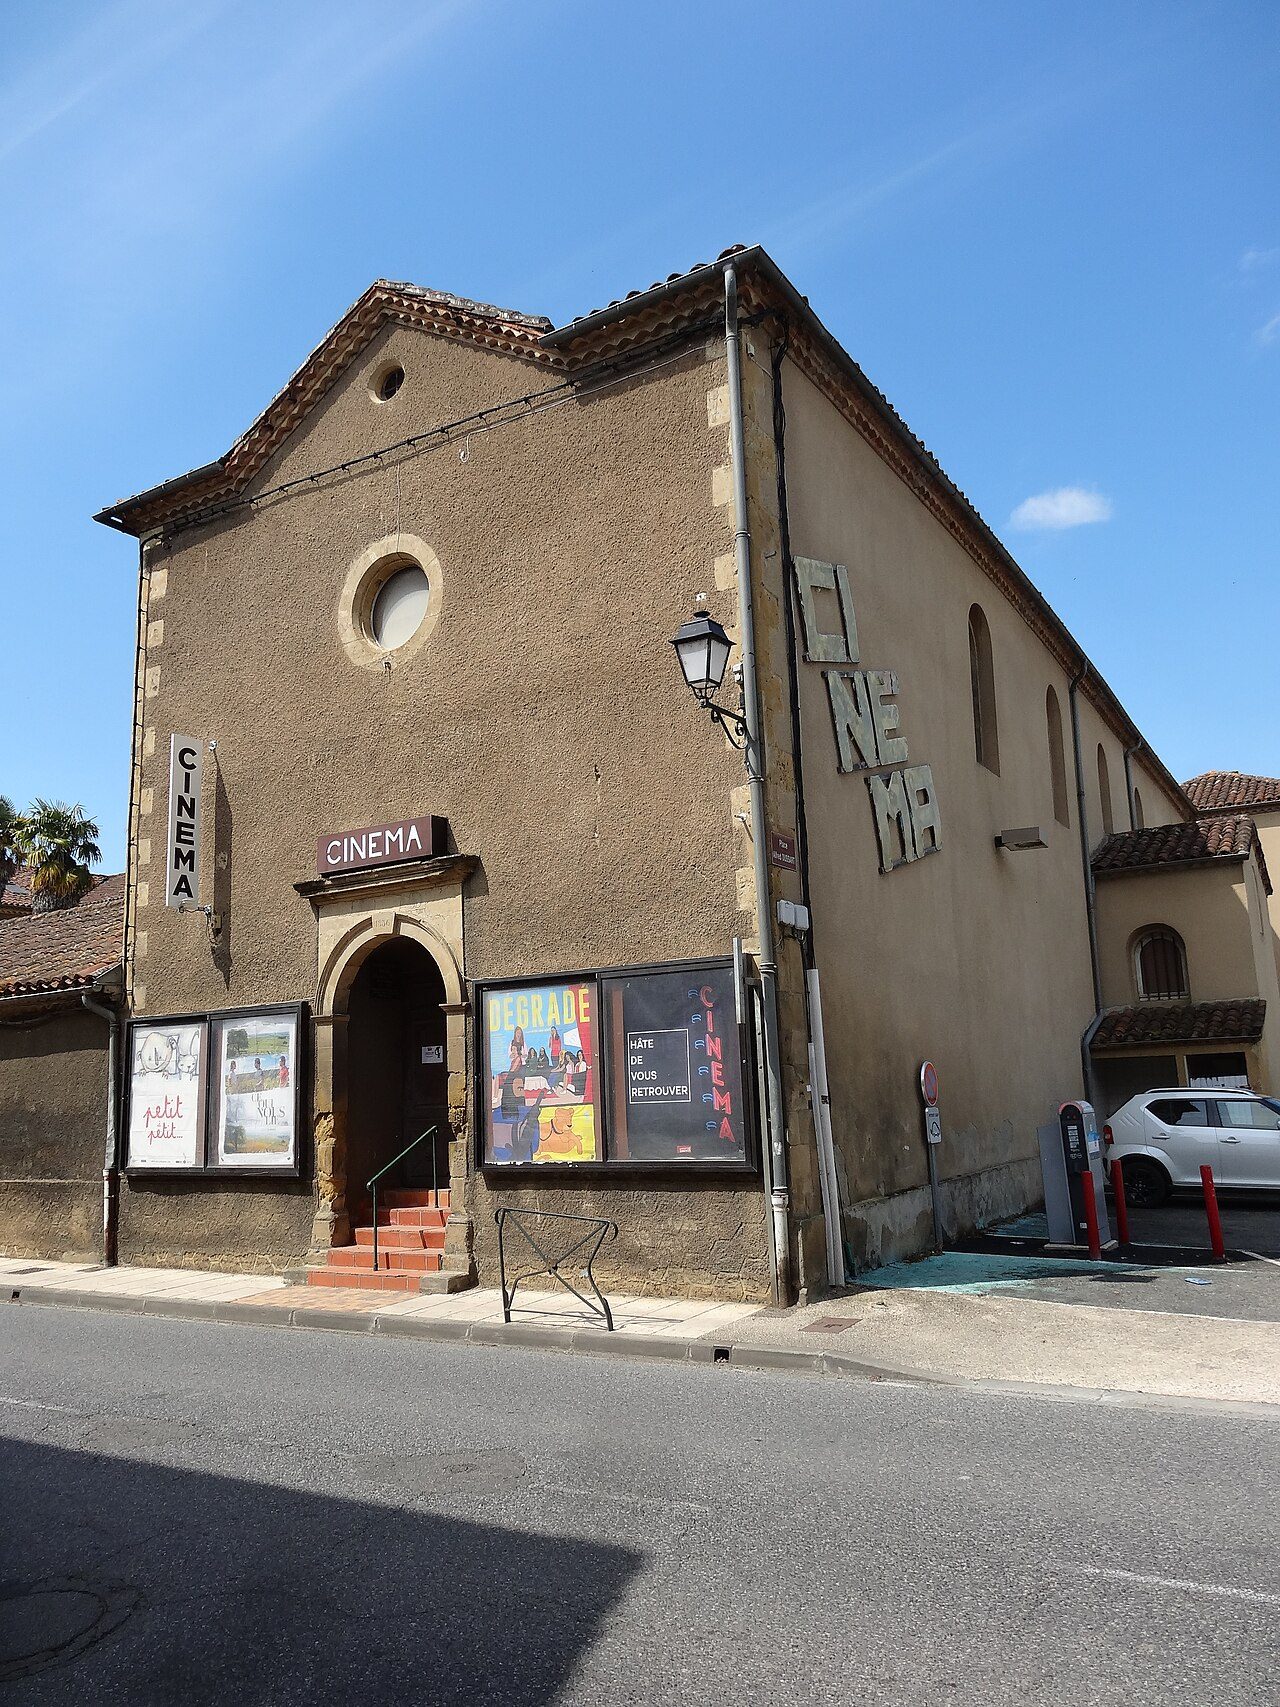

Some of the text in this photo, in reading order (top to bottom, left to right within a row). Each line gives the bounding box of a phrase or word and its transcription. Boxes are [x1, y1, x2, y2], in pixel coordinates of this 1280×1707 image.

[825, 670, 909, 773] NE
[172, 747, 198, 898] CINEMA
[866, 764, 943, 873] MA
[326, 824, 423, 865] CINEMA
[630, 1037, 654, 1050] HÂTE
[630, 1055, 644, 1066] DE
[630, 1070, 658, 1081] VOUS
[700, 985, 736, 1143] CINEMA
[631, 1085, 689, 1097] RETROUVER
[142, 1094, 184, 1128] petit
